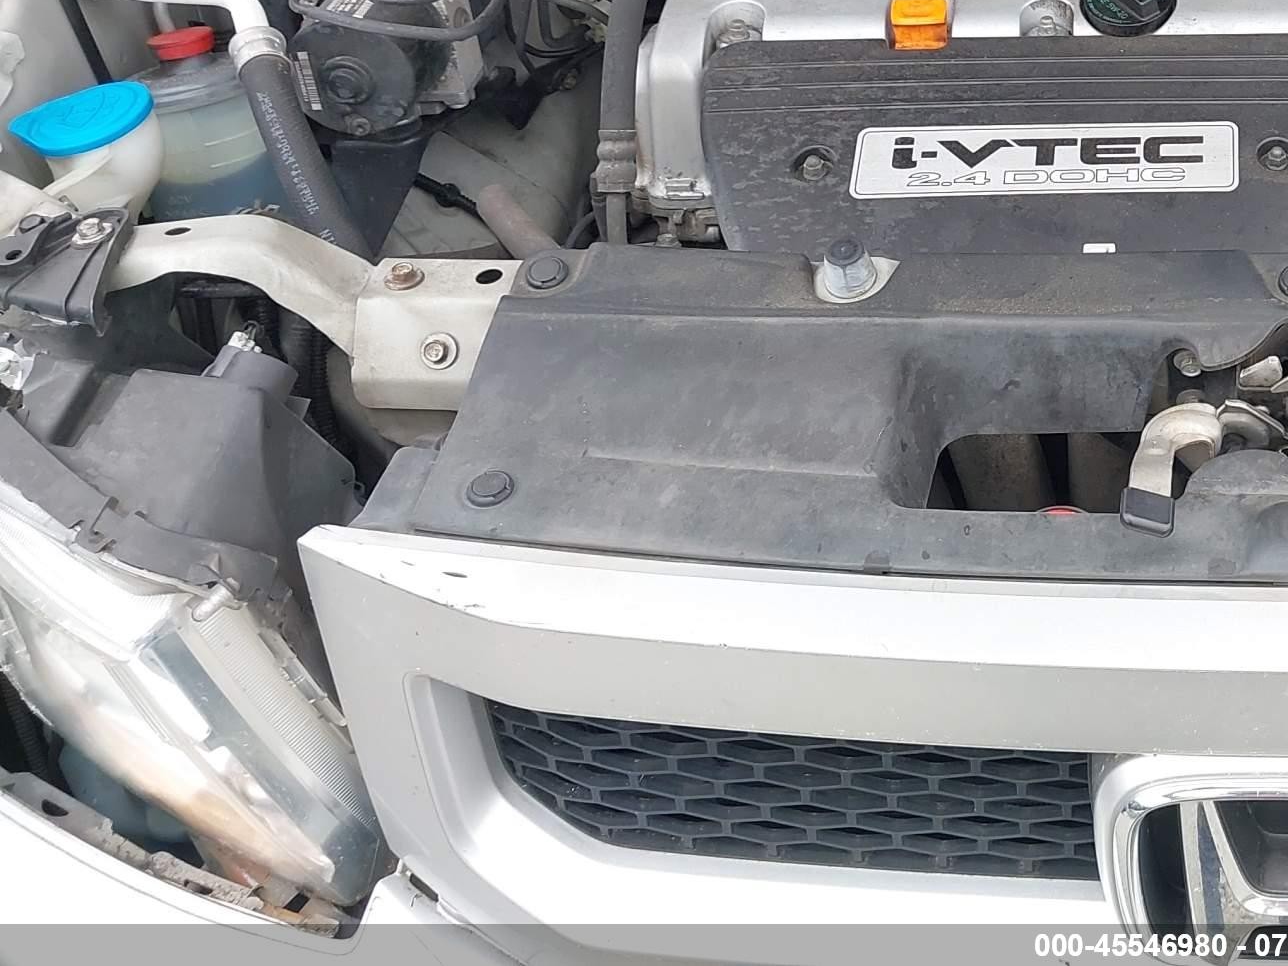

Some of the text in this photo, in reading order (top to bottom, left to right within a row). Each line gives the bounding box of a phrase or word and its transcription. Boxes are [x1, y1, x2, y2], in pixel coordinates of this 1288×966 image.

[891, 136, 1204, 170] i-VTEC
[907, 167, 1186, 187] 2.4 DOHC
